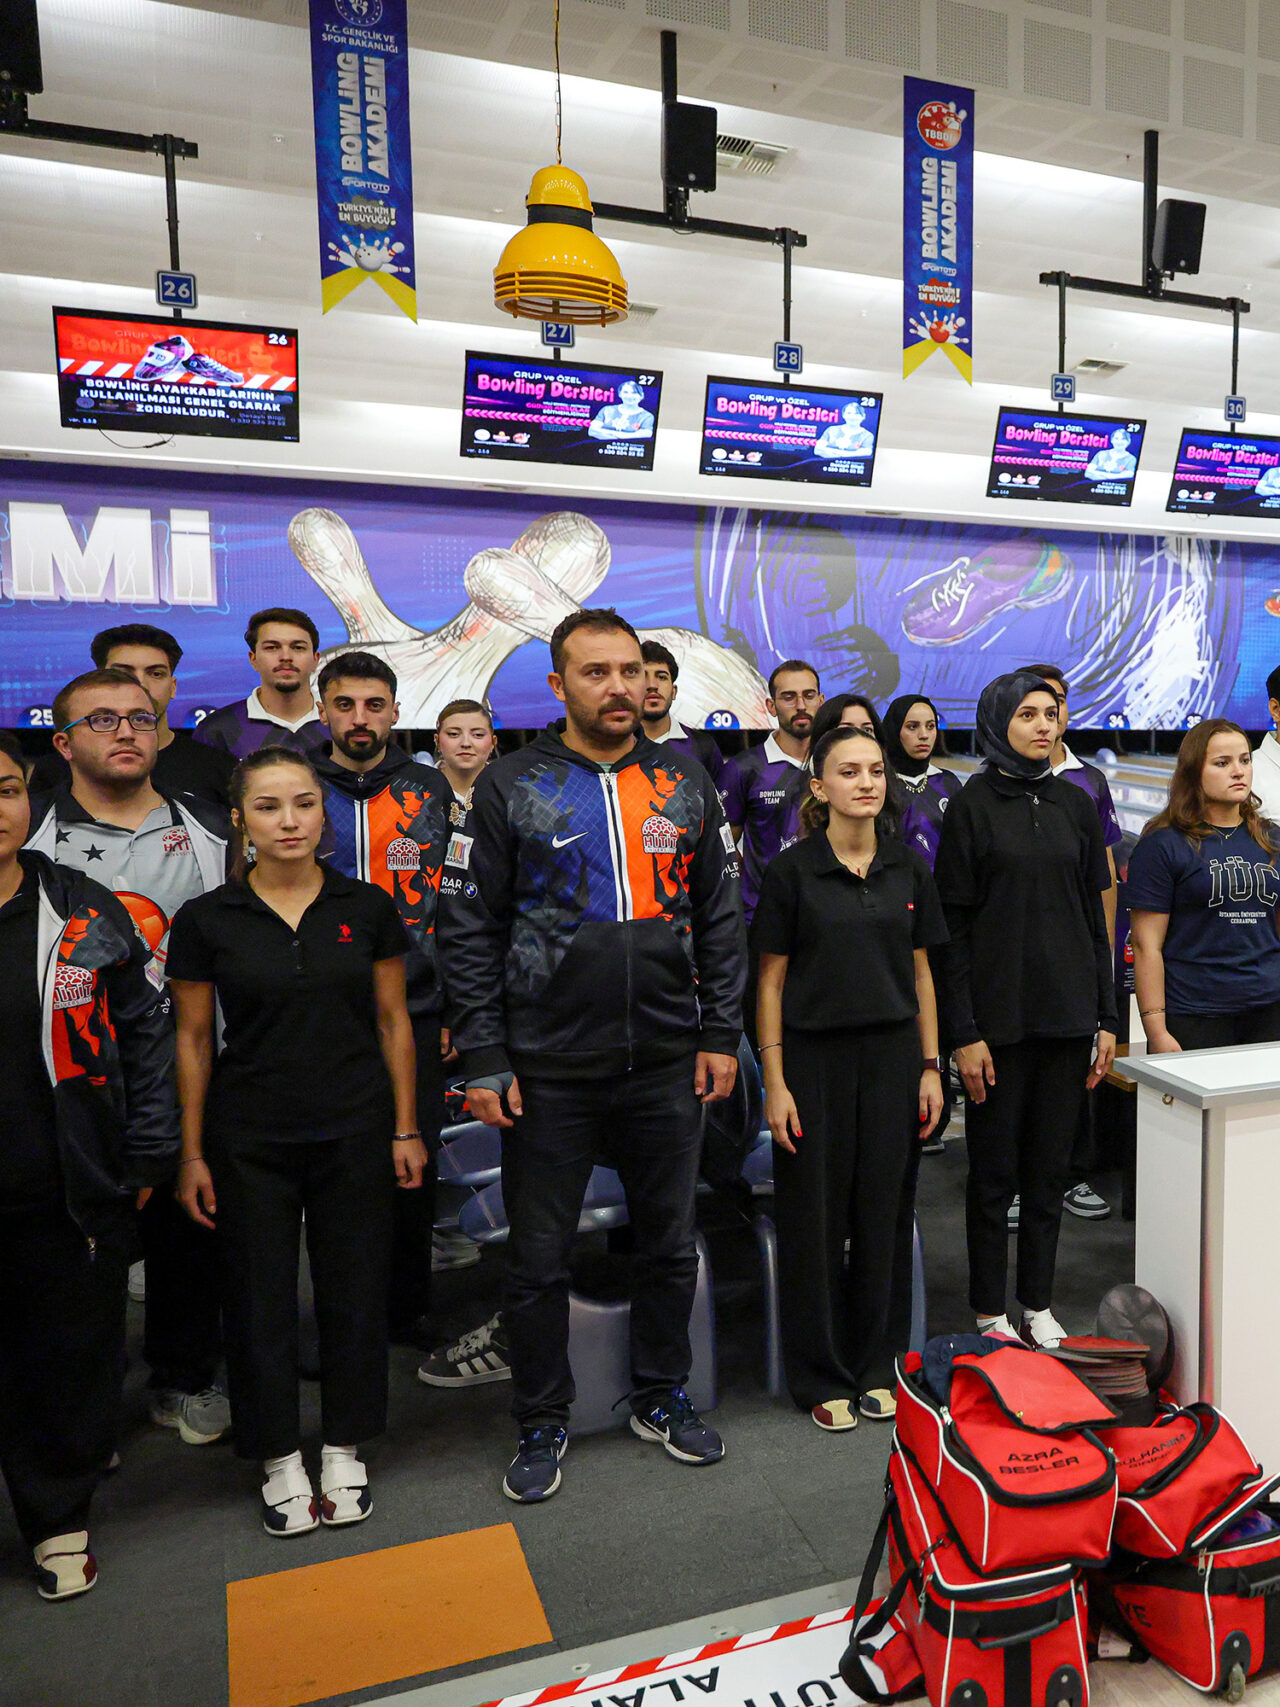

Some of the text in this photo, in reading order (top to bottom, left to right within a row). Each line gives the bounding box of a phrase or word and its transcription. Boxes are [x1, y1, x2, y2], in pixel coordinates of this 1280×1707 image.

[322, 33, 398, 53] SPOR BAKANLIĞI
[383, 34, 396, 43] VE
[164, 281, 191, 299] 26
[546, 324, 568, 338] 27
[267, 333, 288, 346] 26
[778, 350, 798, 365] 28
[513, 371, 542, 380] GRUP
[556, 372, 582, 384] ÖZEL
[638, 375, 655, 386] 27
[153, 384, 275, 401] AYAKKABILARININ
[477, 374, 615, 403] Bowling Dersleri
[1055, 381, 1072, 394] 29
[80, 389, 281, 412] KULLANILMASI GENEL OLARAK
[749, 393, 775, 402] GRUP
[787, 395, 810, 406] ÖZEL
[860, 397, 876, 407] 28
[136, 403, 230, 419] ZORUNLUDUR.
[716, 397, 839, 423] Bowling Dersleri
[1228, 403, 1243, 416] 30
[1126, 423, 1141, 433] 29
[1005, 425, 1109, 448] Bowling Dersleri
[1186, 446, 1279, 466] Bowling Dersleri
[5, 500, 218, 606] Mi
[30, 709, 54, 726] 25
[711, 712, 733, 728] 30
[1108, 715, 1125, 728] 34
[759, 790, 785, 798] BOWLING
[1208, 855, 1280, 908] İÜC
[1007, 1446, 1064, 1462] AZRA
[999, 1455, 1080, 1475] BESLER
